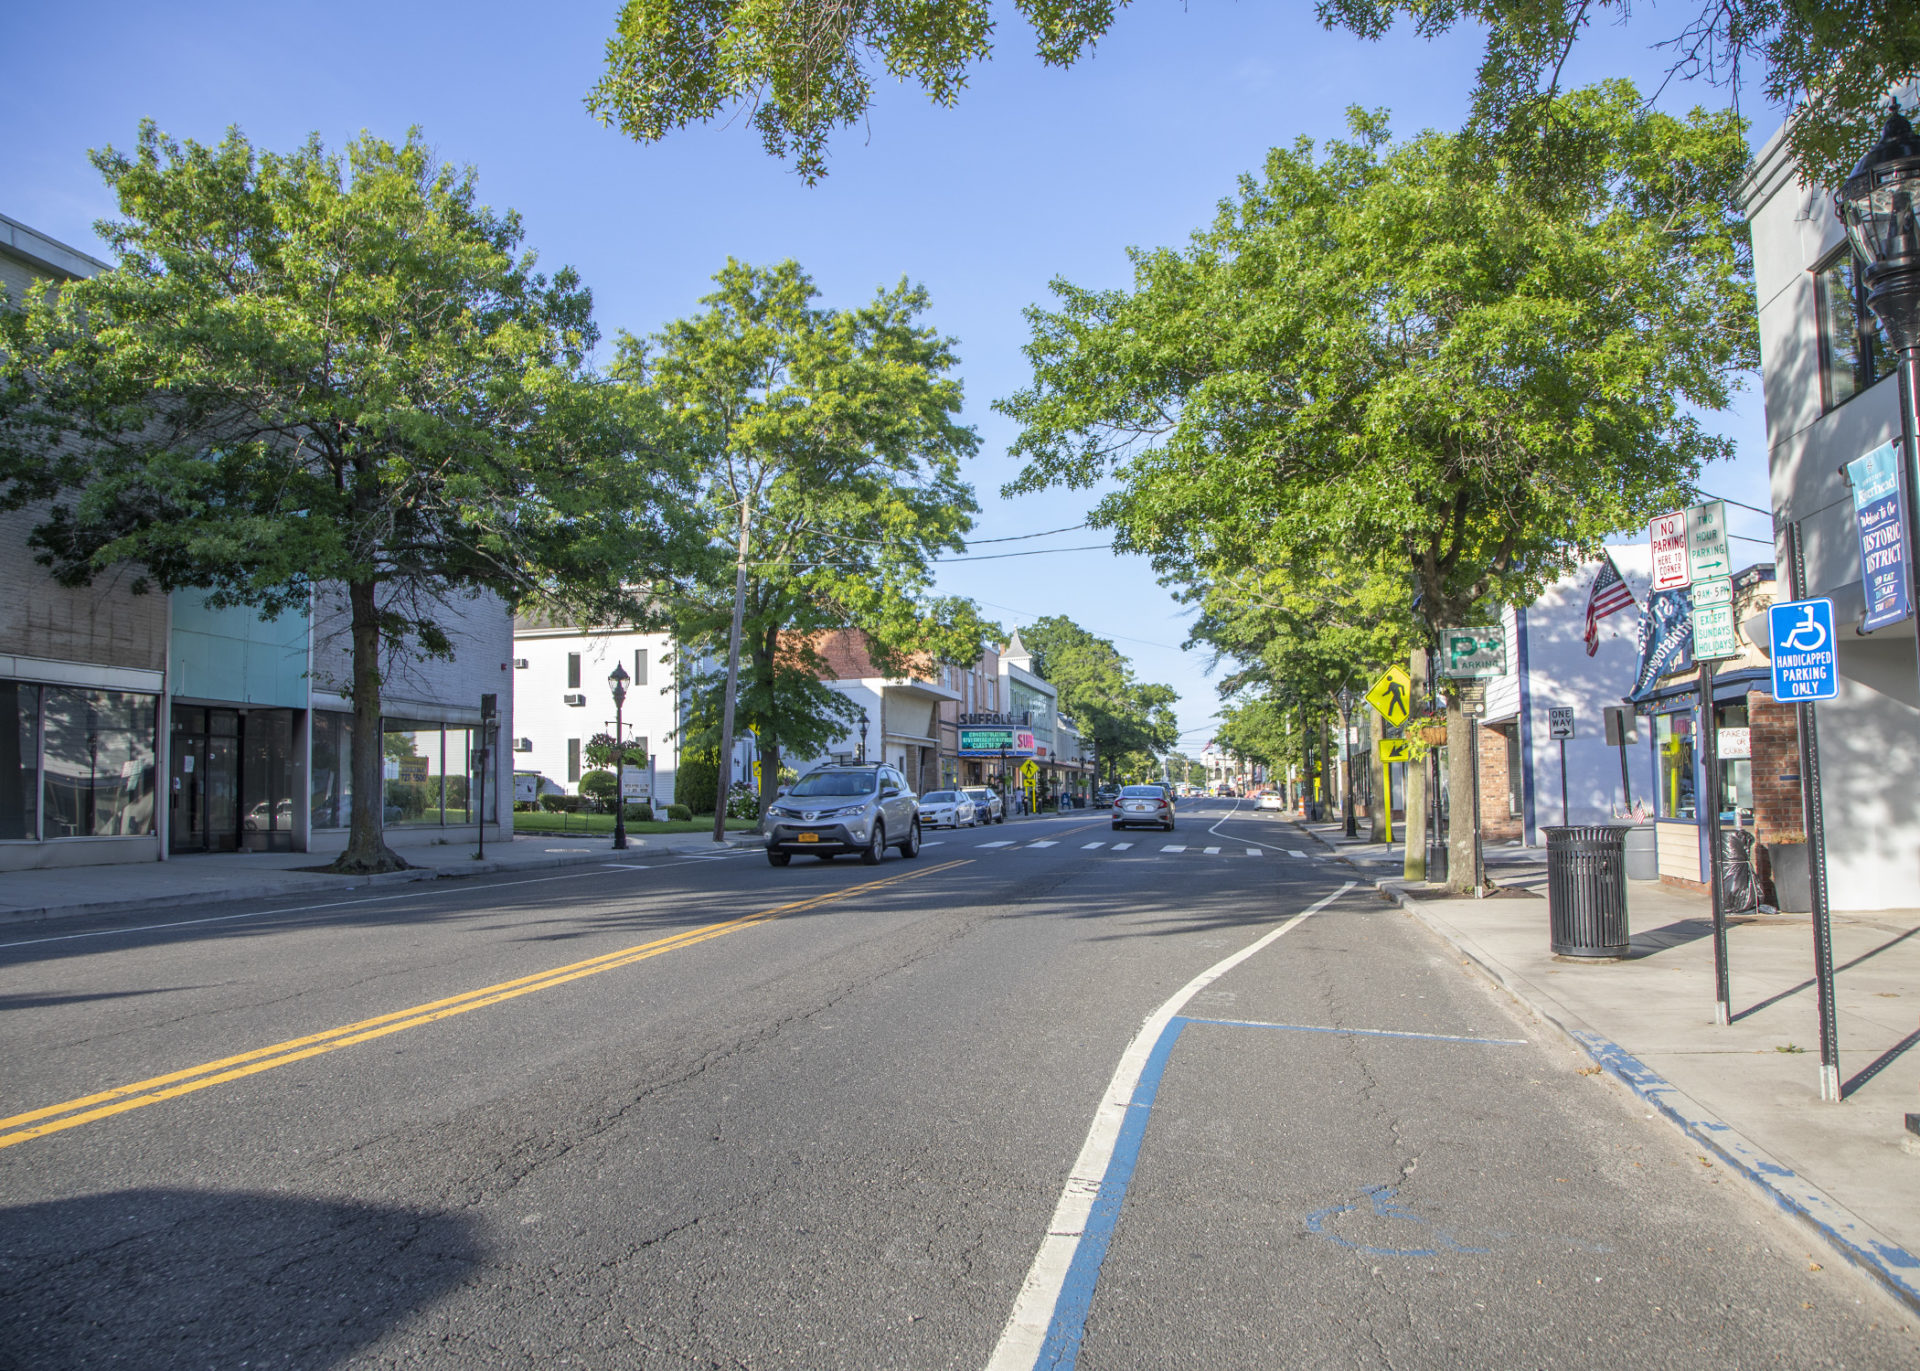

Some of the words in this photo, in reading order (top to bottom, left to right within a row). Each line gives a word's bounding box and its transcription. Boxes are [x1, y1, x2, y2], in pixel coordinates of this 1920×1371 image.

[1697, 513, 1713, 526] TWO
[1660, 521, 1674, 536] NO
[1696, 529, 1717, 542] HOUR
[1653, 534, 1684, 555] PARKING
[1658, 554, 1672, 566] HERE
[1674, 552, 1682, 561] TO
[1692, 544, 1725, 560] PARKING
[1660, 563, 1682, 575] CORNER
[1700, 612, 1727, 626] EXCEPT
[1698, 626, 1731, 639] SUNDAYS
[1699, 640, 1734, 653] HOLIDAYS
[1777, 651, 1831, 668] HANDICAPPED
[1783, 666, 1826, 681] PARKING
[1792, 681, 1818, 695] ONLY
[1552, 710, 1571, 719] ONE
[1552, 719, 1572, 727] WAY
